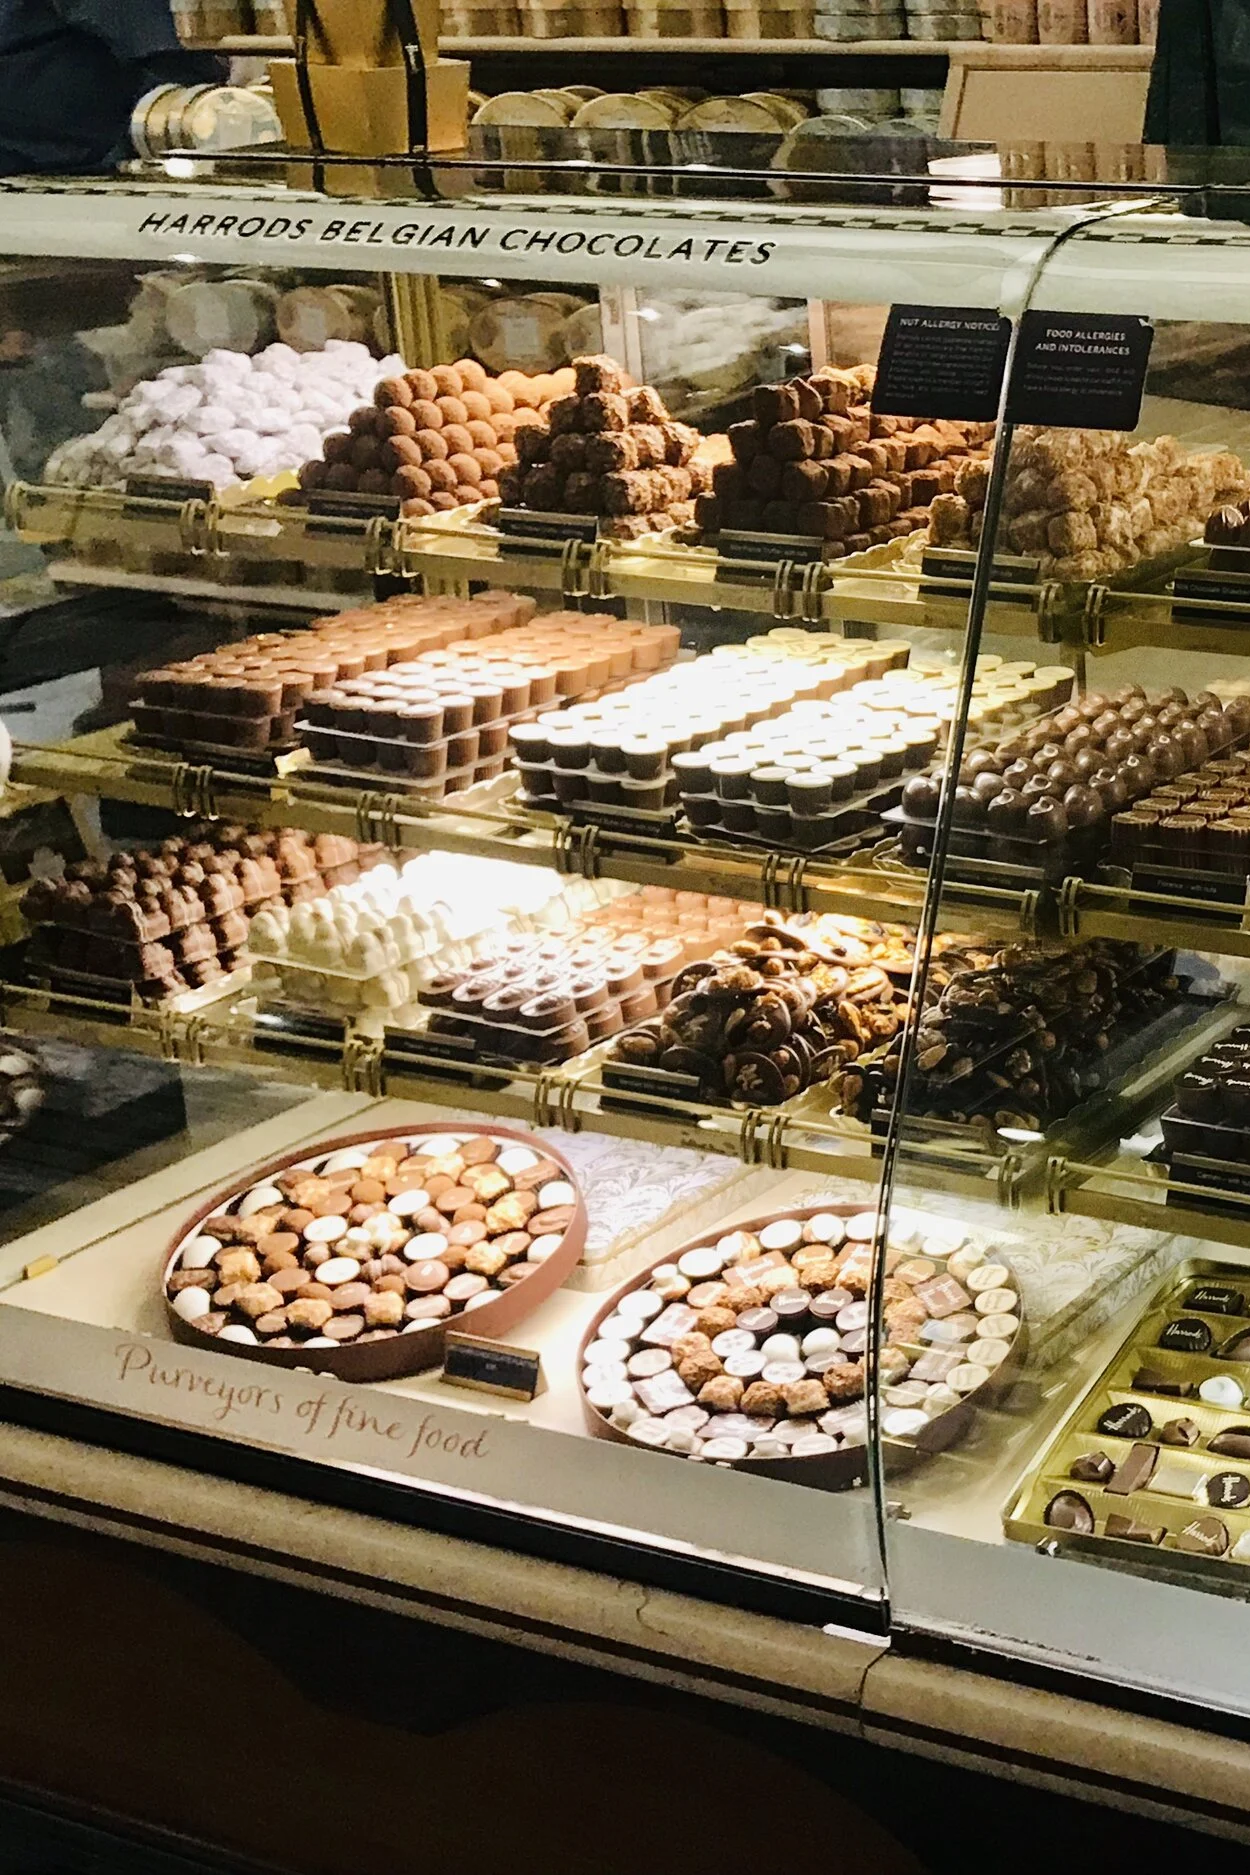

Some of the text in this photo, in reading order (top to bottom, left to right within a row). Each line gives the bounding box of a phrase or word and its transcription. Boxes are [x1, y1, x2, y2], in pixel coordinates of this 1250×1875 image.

[138, 212, 776, 265] HARRODS BELGIAN CHOCOLATES
[900, 318, 919, 327] NUT
[921, 319, 962, 329] ALLERGY
[1046, 328, 1126, 341] FOOD ALLERGIES
[1035, 343, 1131, 356] AND INTOLERANCES
[115, 1343, 490, 1459] Purveyors of fine food
